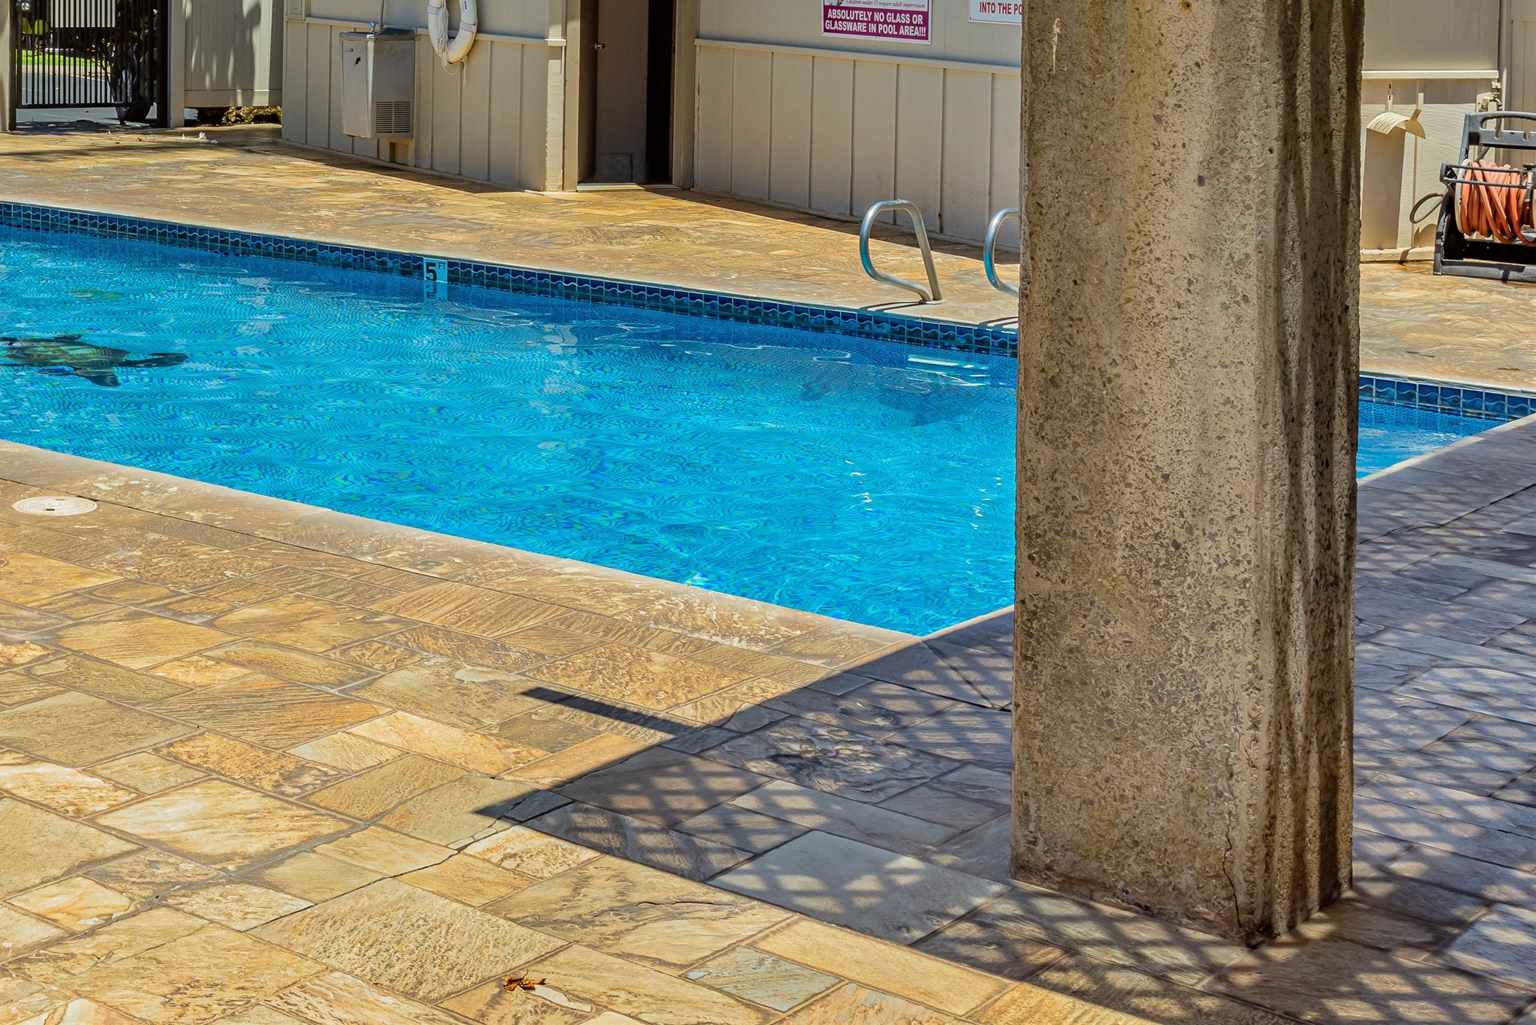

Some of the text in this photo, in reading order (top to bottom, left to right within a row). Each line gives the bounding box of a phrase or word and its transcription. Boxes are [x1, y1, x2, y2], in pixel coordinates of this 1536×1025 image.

[827, 8, 923, 25] ABSOLUTELY NO GLASS OR
[979, 1, 1024, 16] INTO THE PO
[824, 19, 927, 37] GLASSWARE IN POOL AREA!!!
[425, 261, 438, 282] 5
